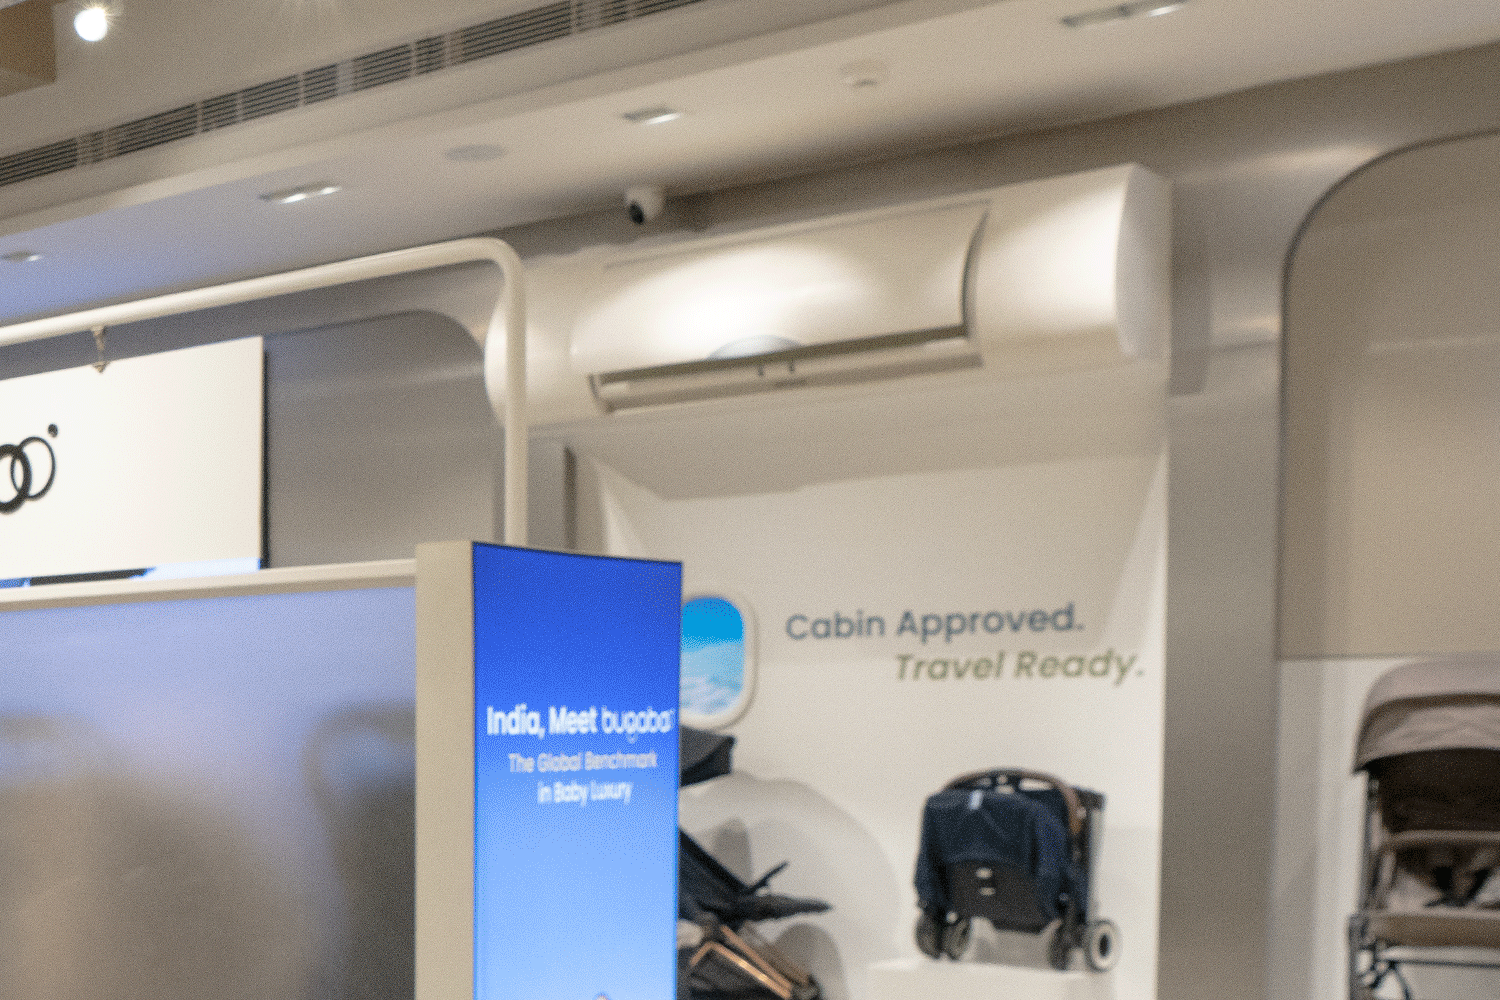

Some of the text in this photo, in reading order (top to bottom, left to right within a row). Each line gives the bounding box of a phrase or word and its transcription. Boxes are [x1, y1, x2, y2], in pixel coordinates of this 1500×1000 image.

[785, 602, 1085, 645] Cabin Approved.
[896, 647, 1145, 688] Travel Ready.
[486, 702, 546, 740] India,
[548, 705, 599, 735] Meet
[508, 750, 658, 773] The Global Benchmark
[553, 779, 589, 807] Baby
